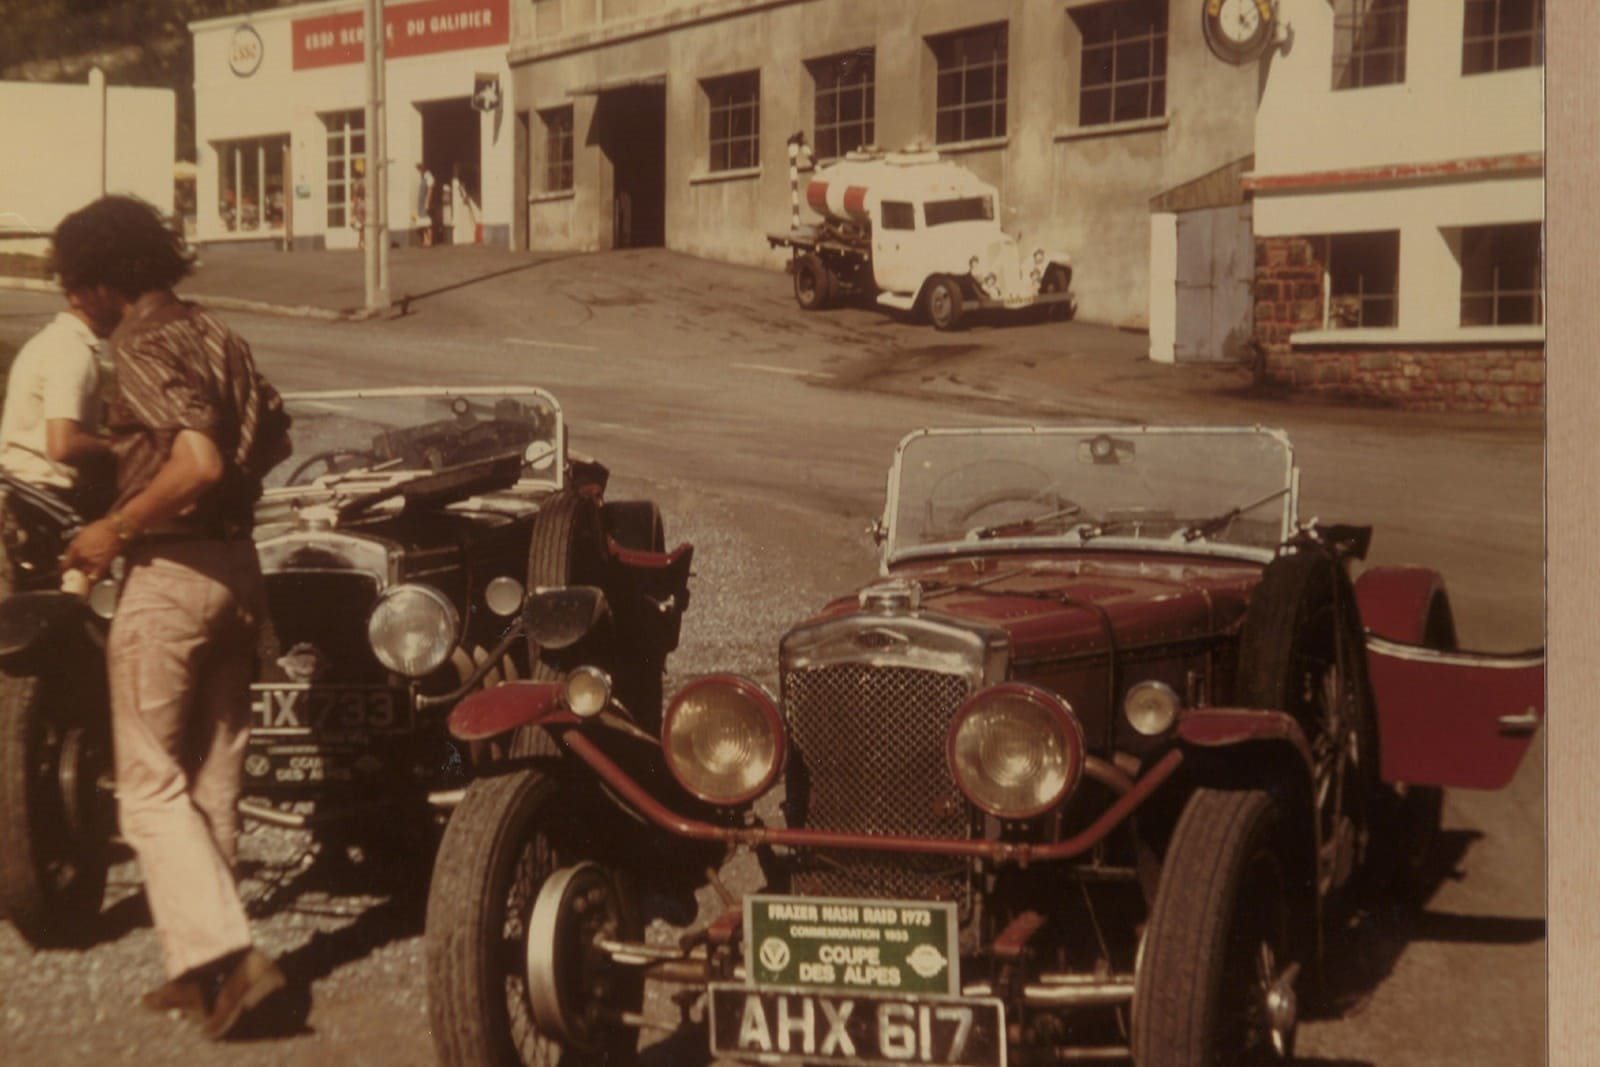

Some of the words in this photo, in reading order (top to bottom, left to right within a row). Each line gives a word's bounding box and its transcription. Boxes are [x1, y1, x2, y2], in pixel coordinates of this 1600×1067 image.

[407, 17, 425, 37] DU
[430, 8, 492, 34] GALIBIER
[768, 903, 819, 922] FRAZER
[821, 905, 859, 924] NASH
[863, 907, 898, 925] RAID
[901, 908, 932, 927] 1973
[819, 944, 881, 965] COUPE
[799, 963, 836, 983] DES
[843, 965, 902, 986] ALPES
[738, 995, 857, 1057] AHX
[877, 1002, 974, 1061] 617
